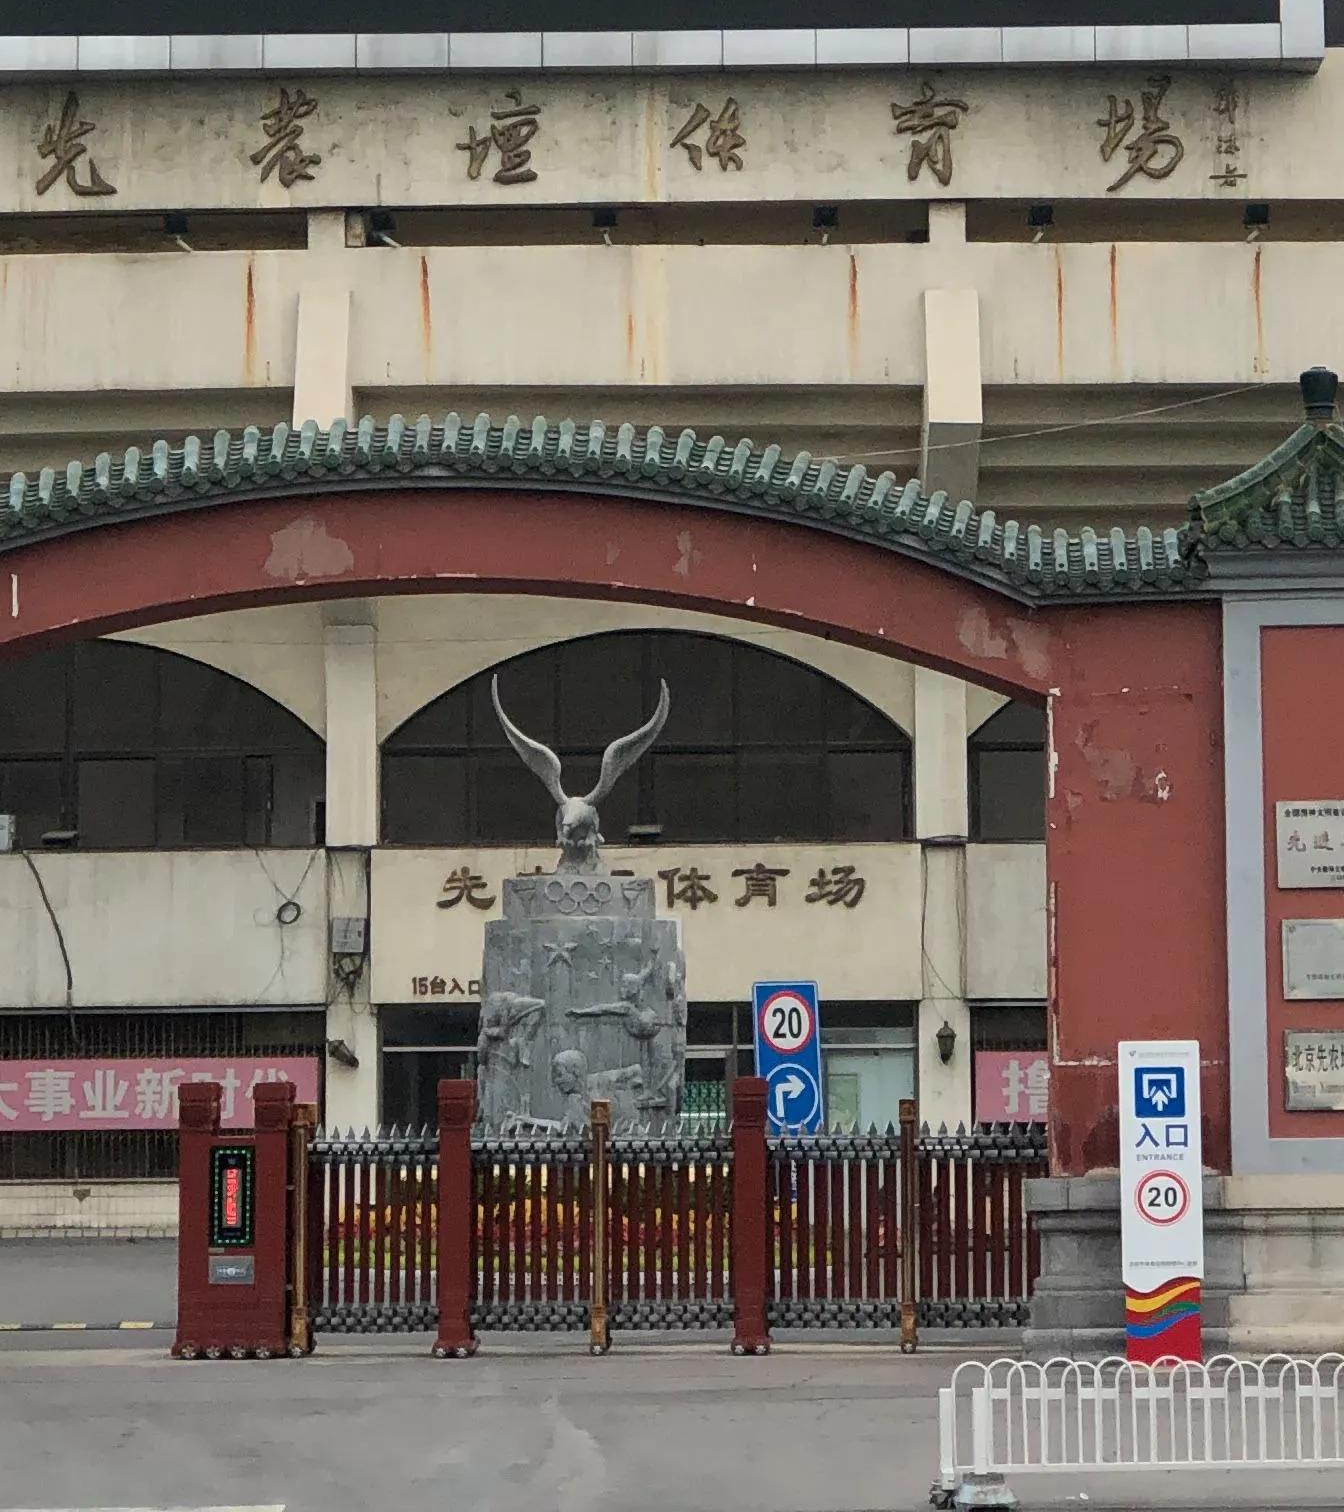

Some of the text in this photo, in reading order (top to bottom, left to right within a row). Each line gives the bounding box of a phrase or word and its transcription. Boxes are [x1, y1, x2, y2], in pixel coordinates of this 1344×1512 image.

[436, 862, 866, 910] 先体育场
[772, 1007, 802, 1038] 20
[1135, 1123, 1188, 1148] 入口
[1136, 1153, 1184, 1161] ENTRANCE
[1148, 1187, 1177, 1208] 20
